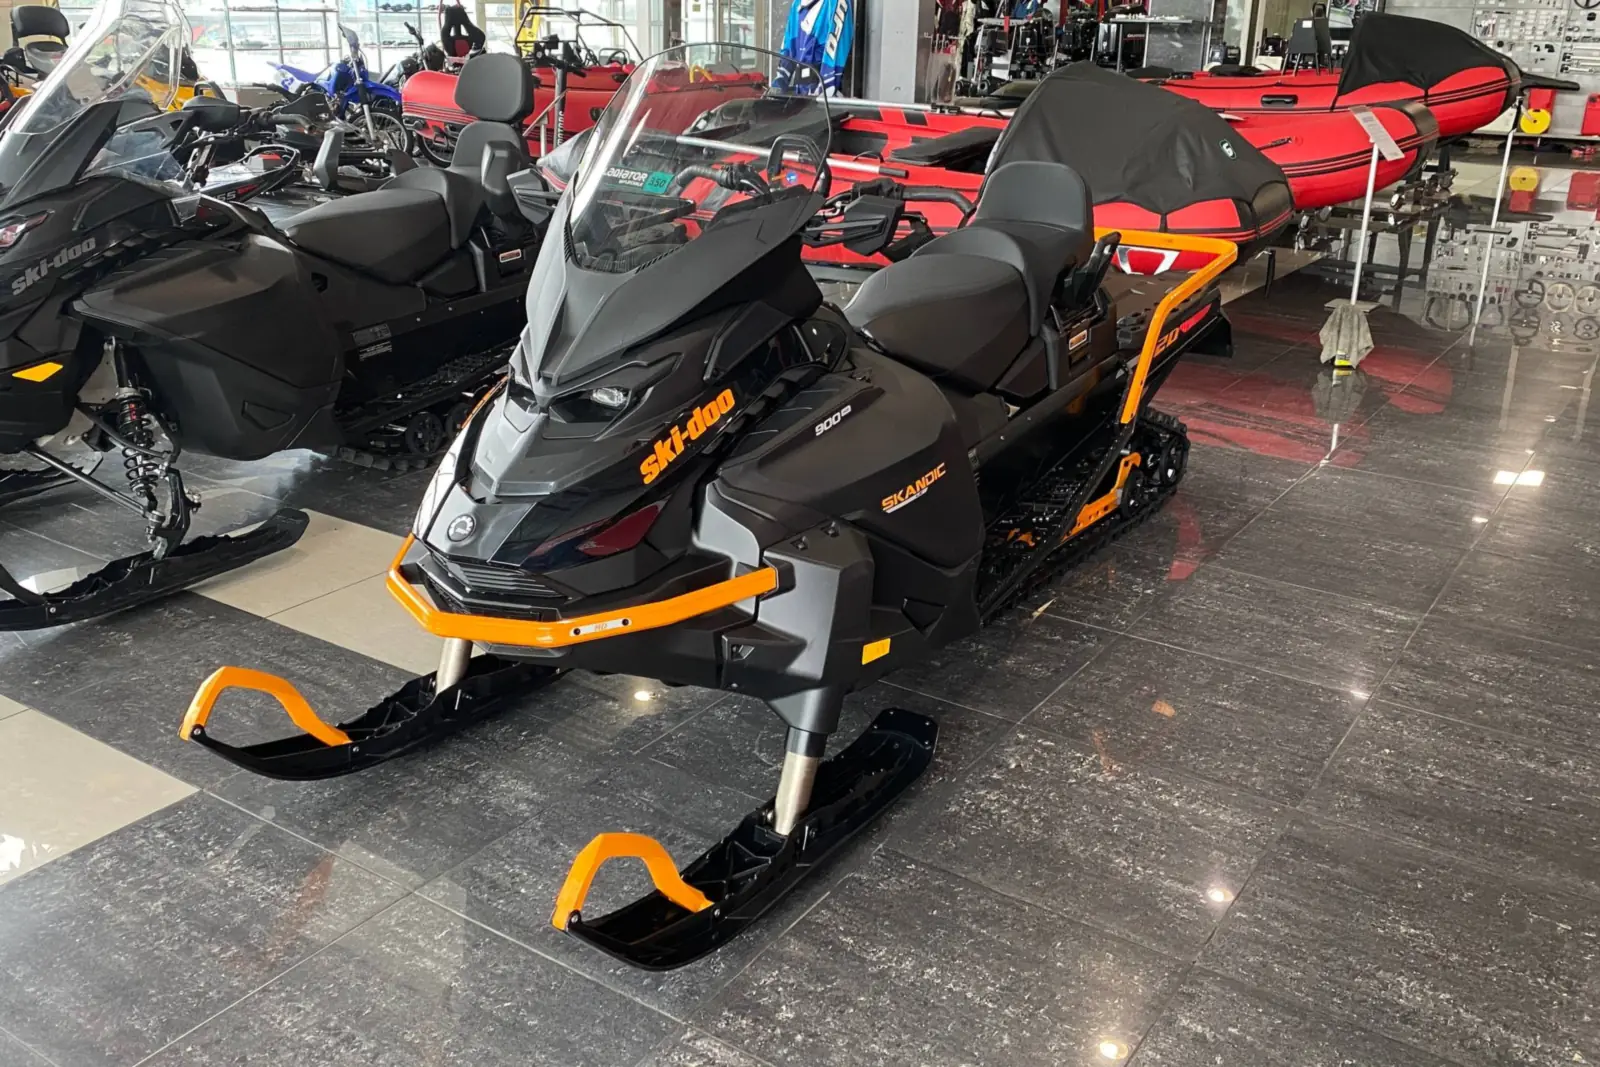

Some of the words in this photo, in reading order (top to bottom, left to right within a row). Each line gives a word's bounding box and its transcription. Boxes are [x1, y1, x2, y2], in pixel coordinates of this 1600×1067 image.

[11, 237, 96, 296] ski-doo
[639, 388, 736, 485] ski-doo
[815, 411, 841, 437] 900
[881, 462, 947, 511] SKANDIC
